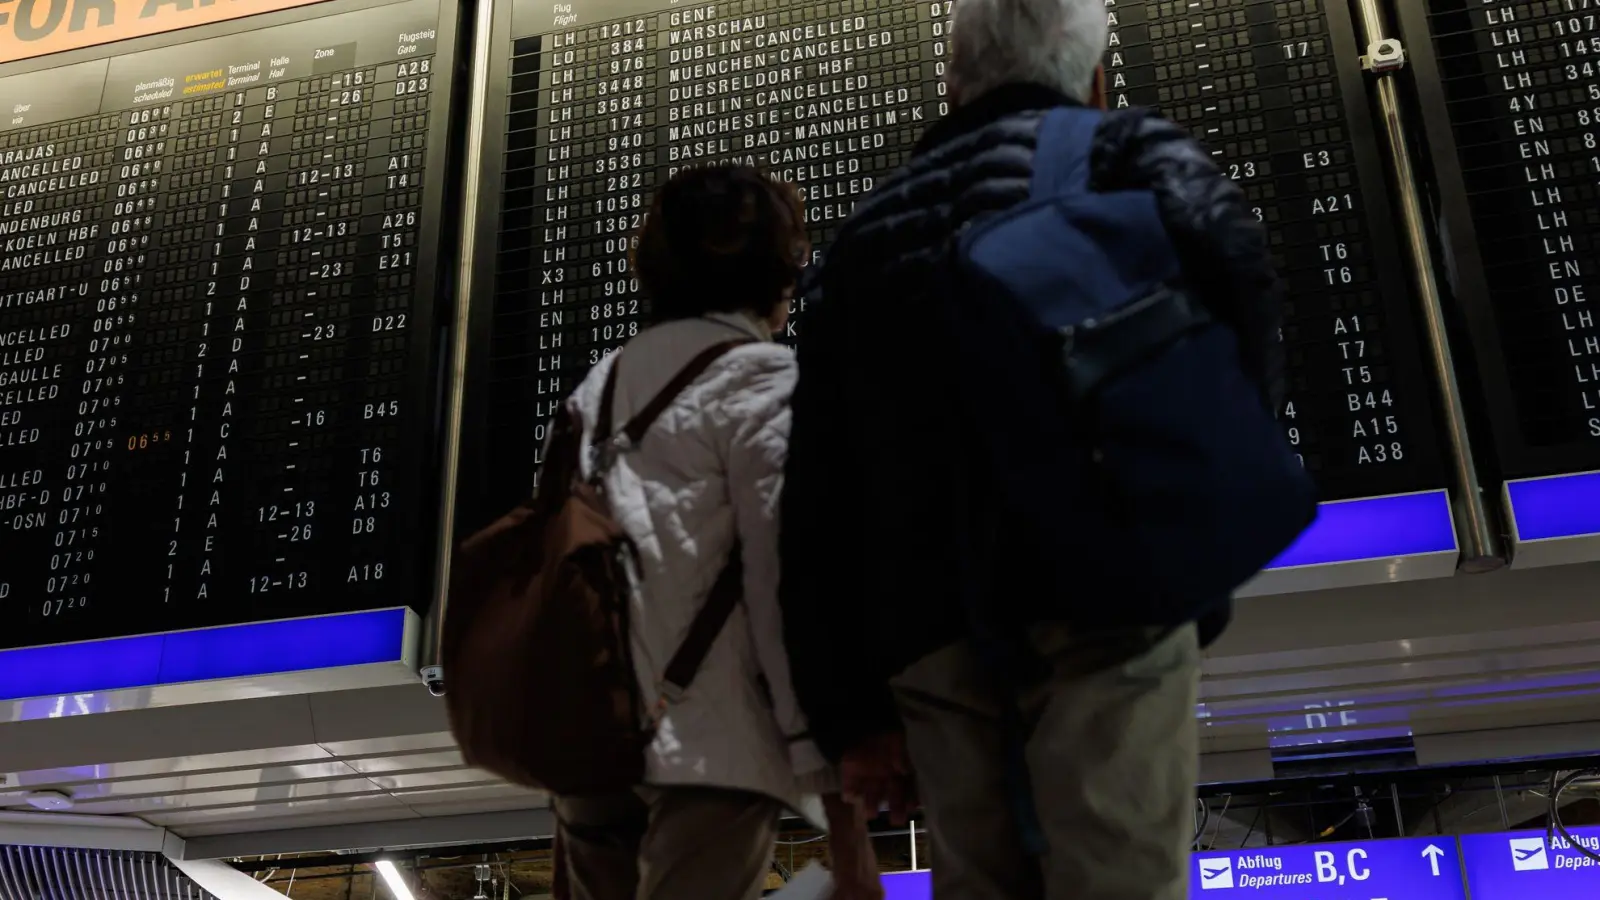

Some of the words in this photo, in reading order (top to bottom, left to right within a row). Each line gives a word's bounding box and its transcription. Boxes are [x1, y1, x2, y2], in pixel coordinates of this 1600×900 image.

[554, 4, 571, 13] Flug
[1486, 7, 1514, 24] LH
[553, 14, 577, 26] Flight
[554, 32, 574, 47] LH
[602, 19, 644, 38] 1212
[671, 6, 715, 25] GENF
[399, 30, 435, 43] Flugsteig
[611, 38, 644, 55] 384
[670, 14, 765, 46] WARSCHAU
[1491, 28, 1520, 46] LH
[314, 49, 334, 59] Zone
[397, 45, 416, 55] Gate
[552, 69, 573, 84] LH
[611, 57, 643, 74] 976
[670, 15, 865, 65] DUBLIN-CANCELLED
[1283, 42, 1307, 58] T7
[1497, 50, 1525, 68] LH
[228, 61, 260, 74] Terminal
[270, 57, 290, 67] Halle
[552, 88, 572, 103] LH
[598, 75, 642, 95] 3448
[670, 30, 891, 84] MUENCHEN-CANCELLED
[185, 69, 222, 82] erwartet
[227, 72, 260, 86] Terminal
[269, 68, 285, 78] Hall
[1503, 72, 1531, 90] LH
[131, 107, 170, 124] 0600
[332, 72, 363, 86] -15
[398, 60, 429, 76] A28
[133, 85, 173, 103] scheduled
[135, 77, 174, 95] planmäßig
[183, 78, 225, 93] estimated
[550, 107, 571, 122] LH
[598, 95, 642, 114] 3584
[670, 64, 803, 102] DUESRELDORF
[819, 57, 853, 75] HBF
[128, 124, 167, 142] 0630
[330, 90, 360, 104] -26
[396, 78, 427, 95] D23
[550, 126, 570, 141] LH
[611, 114, 642, 131] 174
[670, 74, 868, 123] BERLIN-CANCELLED
[1510, 94, 1534, 112] 4Y
[549, 145, 569, 161] LH
[609, 133, 641, 151] 940
[669, 87, 908, 142] MANCHESTE-CANCELLED
[1514, 117, 1543, 135] EN
[125, 142, 164, 160] 0630
[548, 165, 568, 181] LH
[596, 153, 641, 173] 3536
[670, 139, 728, 162] BASEL
[745, 104, 922, 150] BAD-MANNHEIM-K
[1520, 140, 1549, 158] EN
[121, 160, 161, 178] 0640
[1303, 151, 1329, 168] E3
[1525, 163, 1555, 182] LH
[115, 198, 154, 215] 0645
[301, 164, 352, 184] 12-13
[388, 155, 408, 170] A1
[118, 179, 157, 197] 0645
[547, 185, 568, 201] LH
[608, 173, 640, 191] 282
[111, 216, 151, 234] 0648
[388, 174, 407, 189] T4
[1313, 194, 1352, 214] A21
[1531, 187, 1561, 206] LH
[546, 206, 567, 222] LH
[596, 194, 640, 213] 1058
[545, 226, 566, 242] LH
[596, 214, 640, 234] 1362
[1538, 211, 1567, 230] LH
[104, 255, 144, 273] 0650
[294, 222, 346, 242] 12-13
[383, 212, 415, 229] A26
[108, 236, 148, 253] 0650
[1320, 243, 1347, 261] T6
[1544, 235, 1574, 254] LH
[101, 274, 140, 292] 0651
[382, 233, 401, 248] T5
[544, 247, 565, 263] LH
[542, 268, 563, 284] X3
[1324, 267, 1351, 285] T6
[1549, 260, 1580, 279] EN
[97, 294, 137, 312] 0655
[310, 263, 341, 278] -23
[379, 252, 410, 269] E21
[542, 289, 563, 306] LH
[605, 279, 638, 296] 900
[1555, 285, 1585, 305] DE
[540, 311, 562, 327] EN
[591, 300, 638, 320] 8852
[94, 315, 134, 332] 0655
[1335, 316, 1360, 334] A1
[86, 355, 127, 373] 0705
[302, 324, 335, 340] -23
[373, 314, 405, 332] D22
[90, 335, 131, 353] 0700
[540, 332, 561, 349] LH
[593, 322, 637, 341] 1028
[1338, 340, 1364, 359] T7
[1342, 366, 1371, 384] T5
[1348, 390, 1393, 411] B44
[71, 440, 113, 458] 0705
[128, 433, 170, 450] 0655
[291, 410, 324, 426] -16
[364, 401, 398, 419] B45
[1353, 416, 1397, 437] A15
[1359, 442, 1403, 464] A38
[63, 483, 106, 502] 0710
[361, 447, 381, 464] T6
[67, 461, 109, 480] 0710
[59, 505, 102, 524] 0710
[359, 470, 379, 487] T6
[55, 527, 98, 547] 0715
[259, 501, 314, 522] 12-13
[354, 492, 390, 511] A13
[51, 550, 94, 570] 0720
[278, 524, 311, 541] -26
[353, 517, 375, 534] D8
[43, 597, 86, 616] 0720
[250, 572, 307, 593] 12-13
[347, 563, 383, 582] A18
[1551, 834, 1600, 850] Ablug
[1236, 853, 1283, 870] Abflug
[1313, 846, 1372, 887] B,C
[1237, 869, 1314, 890] Departures
